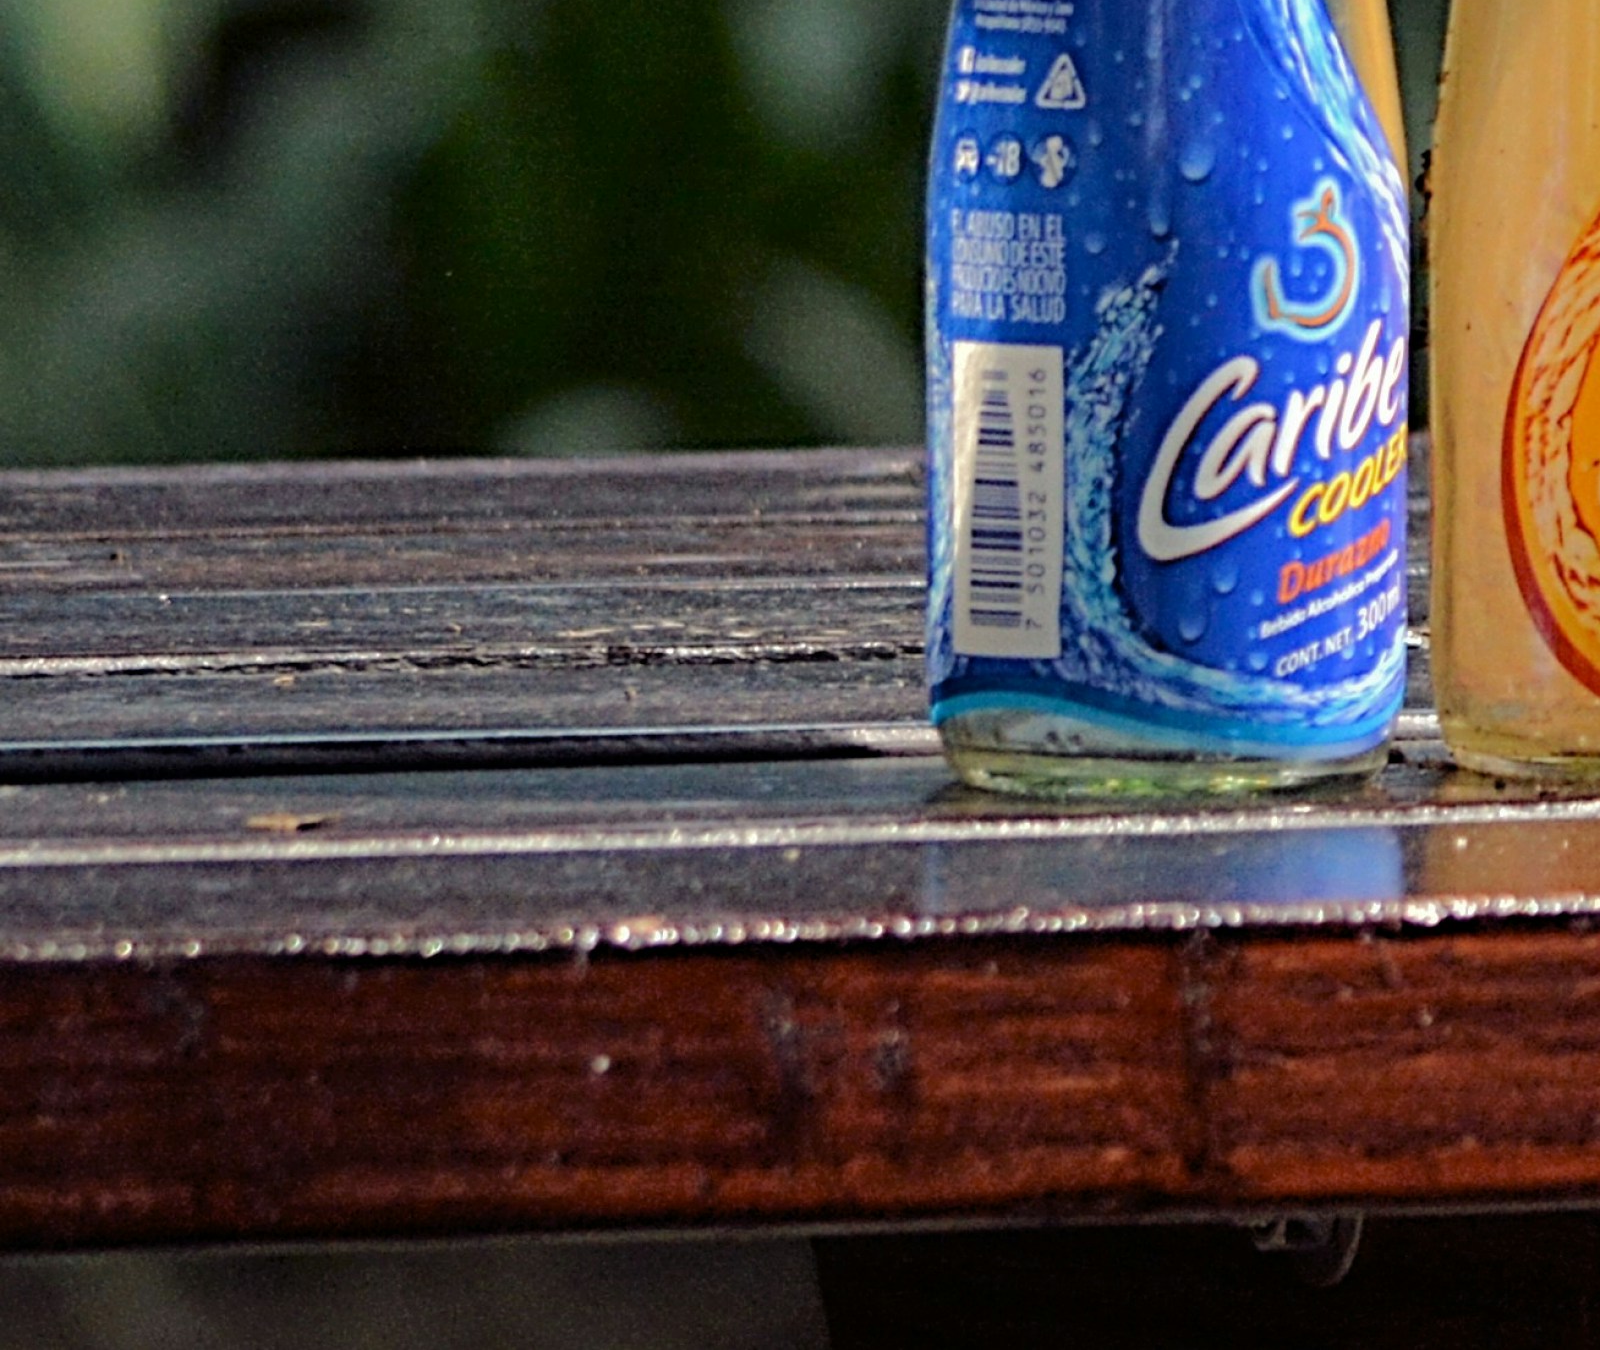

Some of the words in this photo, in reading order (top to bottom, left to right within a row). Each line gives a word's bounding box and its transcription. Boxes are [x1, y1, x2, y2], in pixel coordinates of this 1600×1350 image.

[1018, 213, 1041, 241] EN
[1011, 295, 1066, 324] SALUD
[1028, 367, 1046, 473] 485016
[1138, 318, 1405, 561] Caribe
[1026, 492, 1047, 595] 501032
[1274, 641, 1323, 679] CONT.
